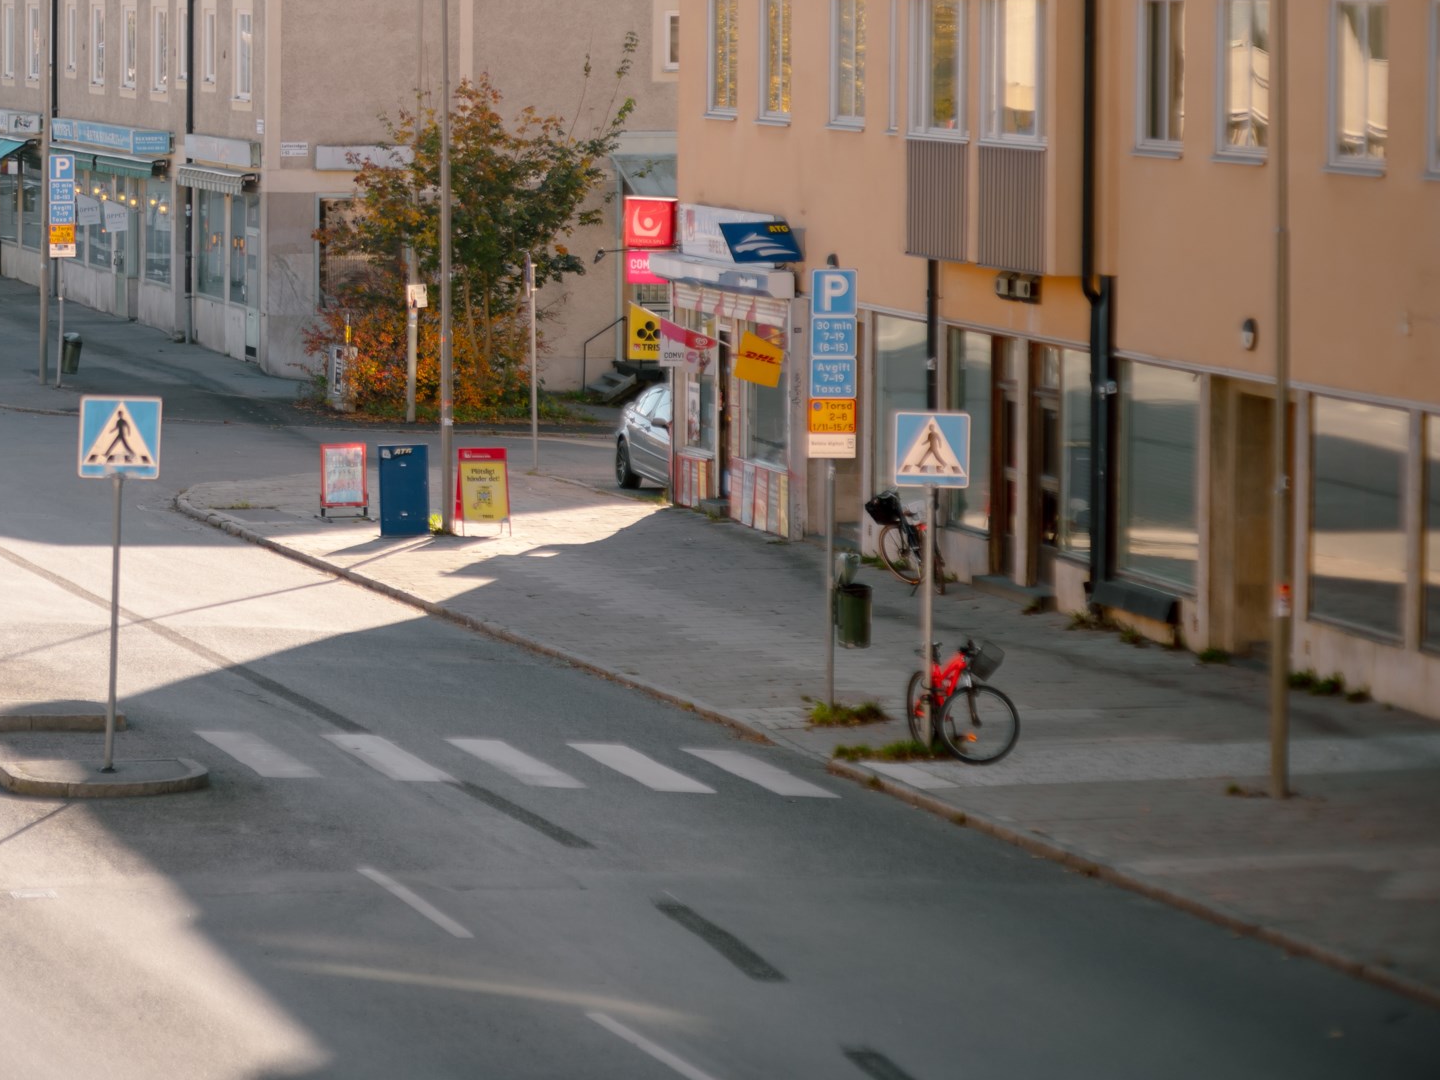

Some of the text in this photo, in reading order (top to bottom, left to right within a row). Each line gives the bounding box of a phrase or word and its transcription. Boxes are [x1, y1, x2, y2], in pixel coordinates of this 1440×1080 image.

[55, 157, 70, 178] P
[768, 225, 789, 233] ATG
[824, 274, 849, 311] P
[816, 321, 852, 330] 30 min
[823, 332, 845, 341] 7-19
[819, 343, 849, 353] (8-15)
[745, 350, 777, 364] DHL
[816, 363, 851, 373] Avgift
[823, 374, 845, 382] 7-19
[815, 385, 852, 393] Taxa 5
[825, 402, 853, 410] Torsd
[812, 423, 854, 431] 1/11-15/5
